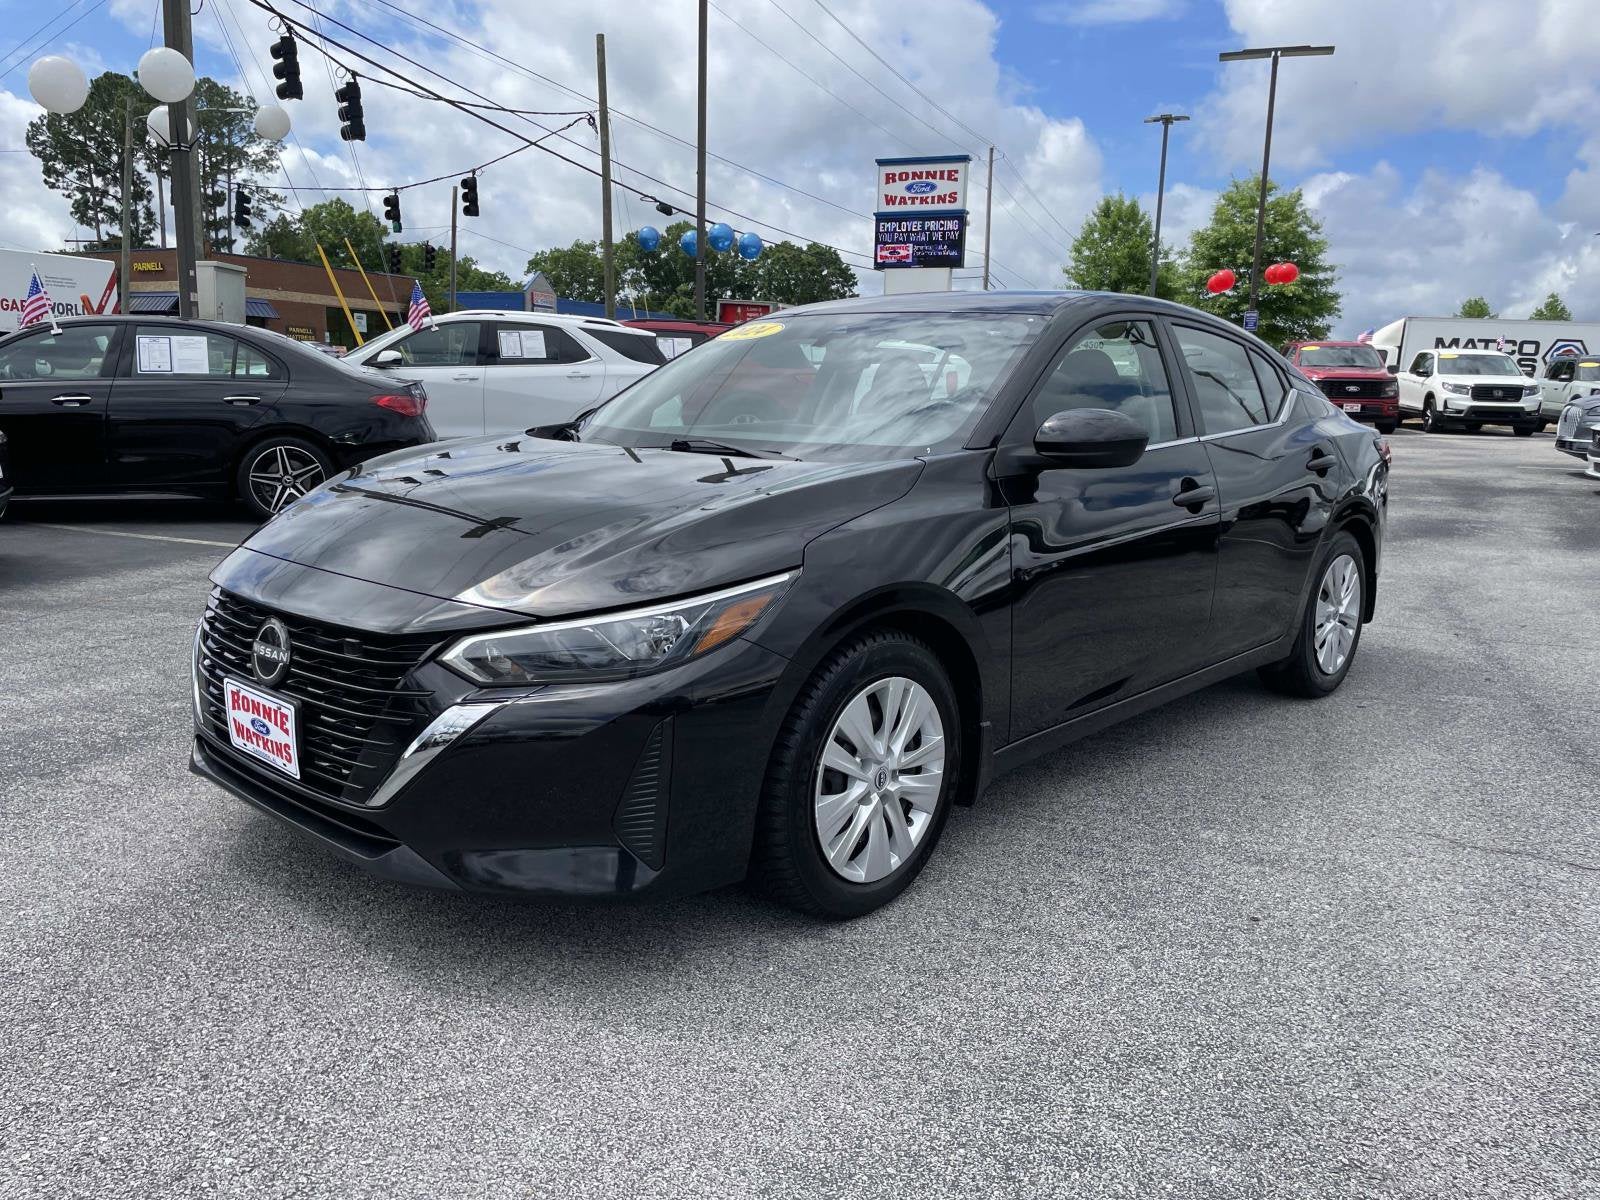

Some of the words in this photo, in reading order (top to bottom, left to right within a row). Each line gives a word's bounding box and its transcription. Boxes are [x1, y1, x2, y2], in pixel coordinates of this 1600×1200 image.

[885, 169, 959, 185] RONNIE
[884, 191, 958, 206] WATKINS
[880, 221, 922, 232] EMPLOYEE
[925, 220, 959, 231] PRICING
[879, 233, 893, 242] YOU
[894, 233, 908, 242] PAY
[910, 231, 931, 241] WHAT
[932, 231, 943, 241] WE
[946, 231, 960, 240] PAY
[133, 262, 164, 271] PARNELL
[1435, 337, 1540, 356] MATCO
[254, 643, 288, 662] NISSAN
[231, 689, 290, 736] RONNIE
[232, 717, 292, 764] WATKINS
